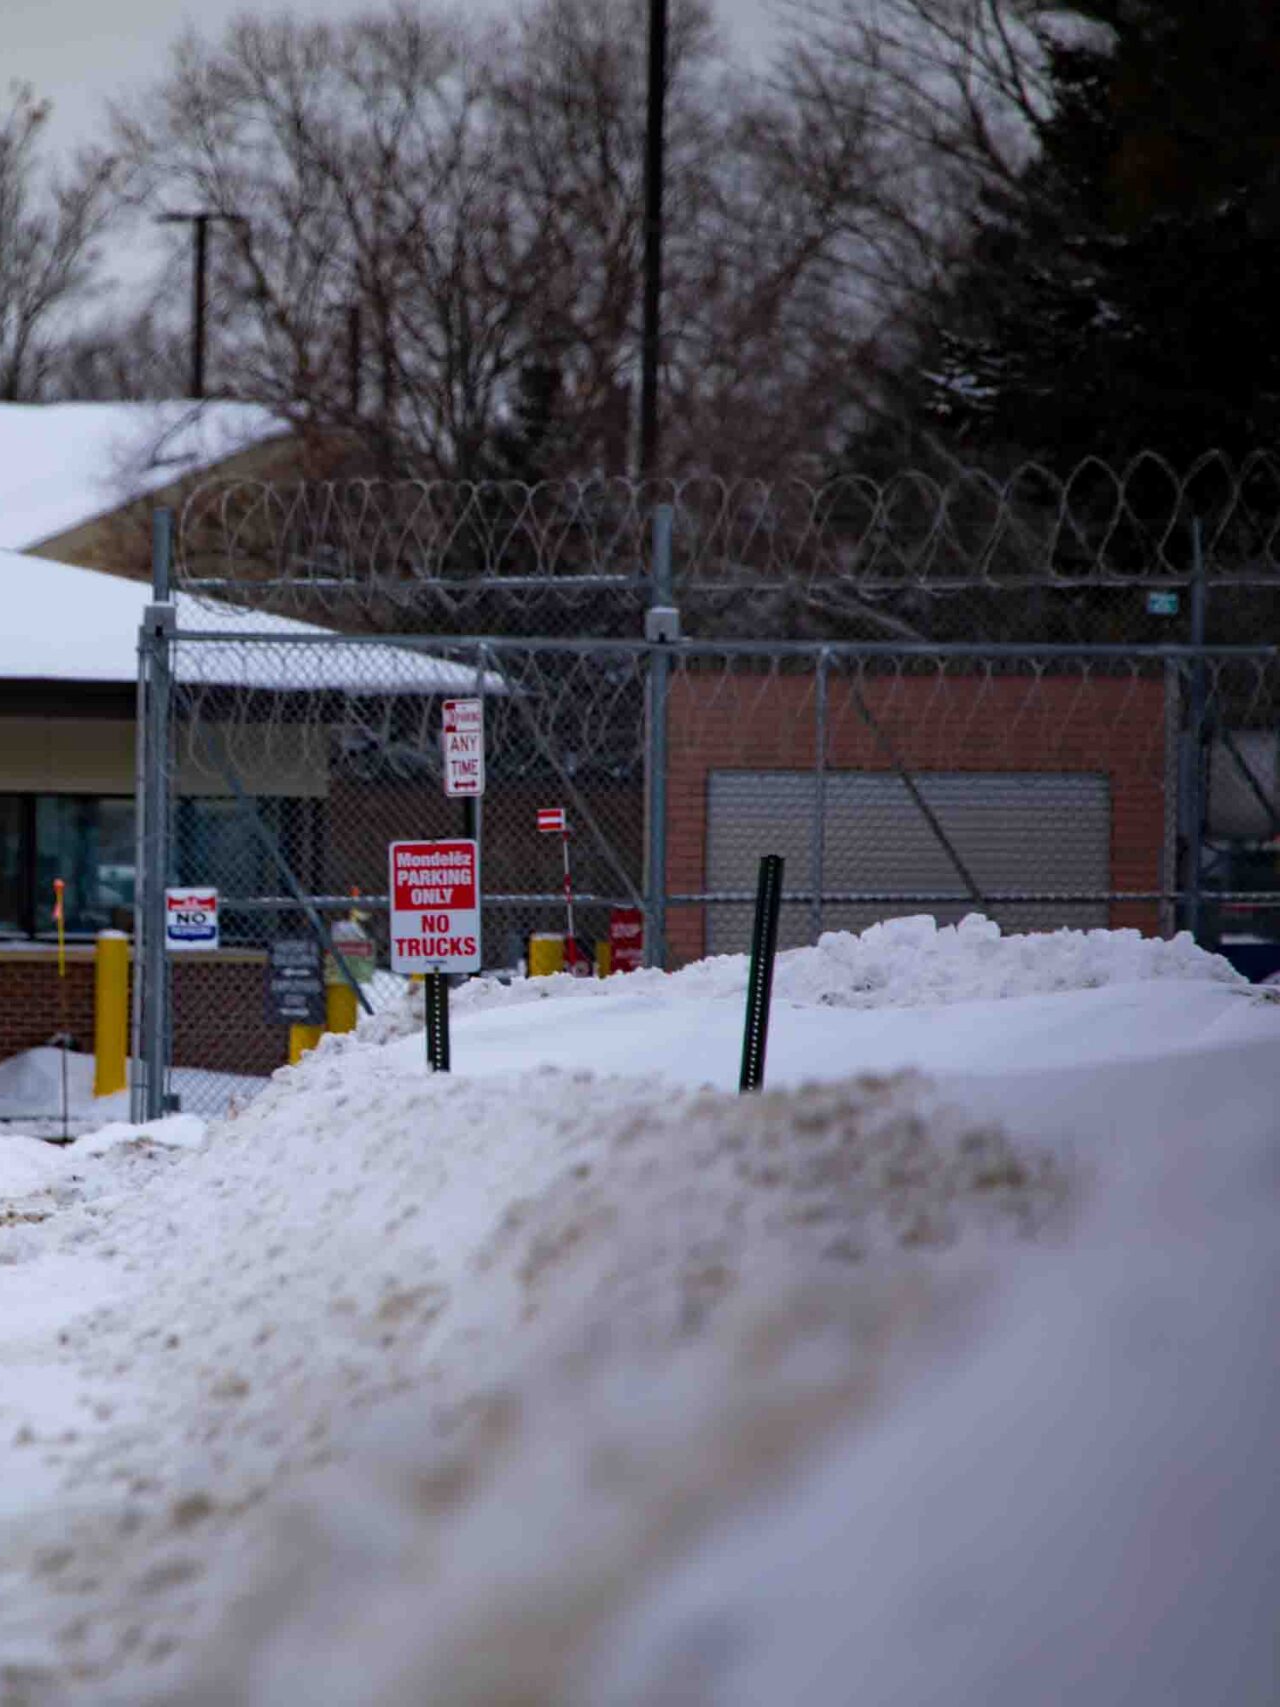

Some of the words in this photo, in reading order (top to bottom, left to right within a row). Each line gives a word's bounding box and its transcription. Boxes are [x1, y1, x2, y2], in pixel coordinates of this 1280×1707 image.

[450, 735, 477, 752] ANY
[451, 759, 478, 776] TIME
[397, 868, 471, 886] PARKING
[411, 887, 453, 905] ONLY
[176, 912, 206, 924] NO
[421, 914, 449, 933] NO
[396, 937, 476, 957] TRUCKS
